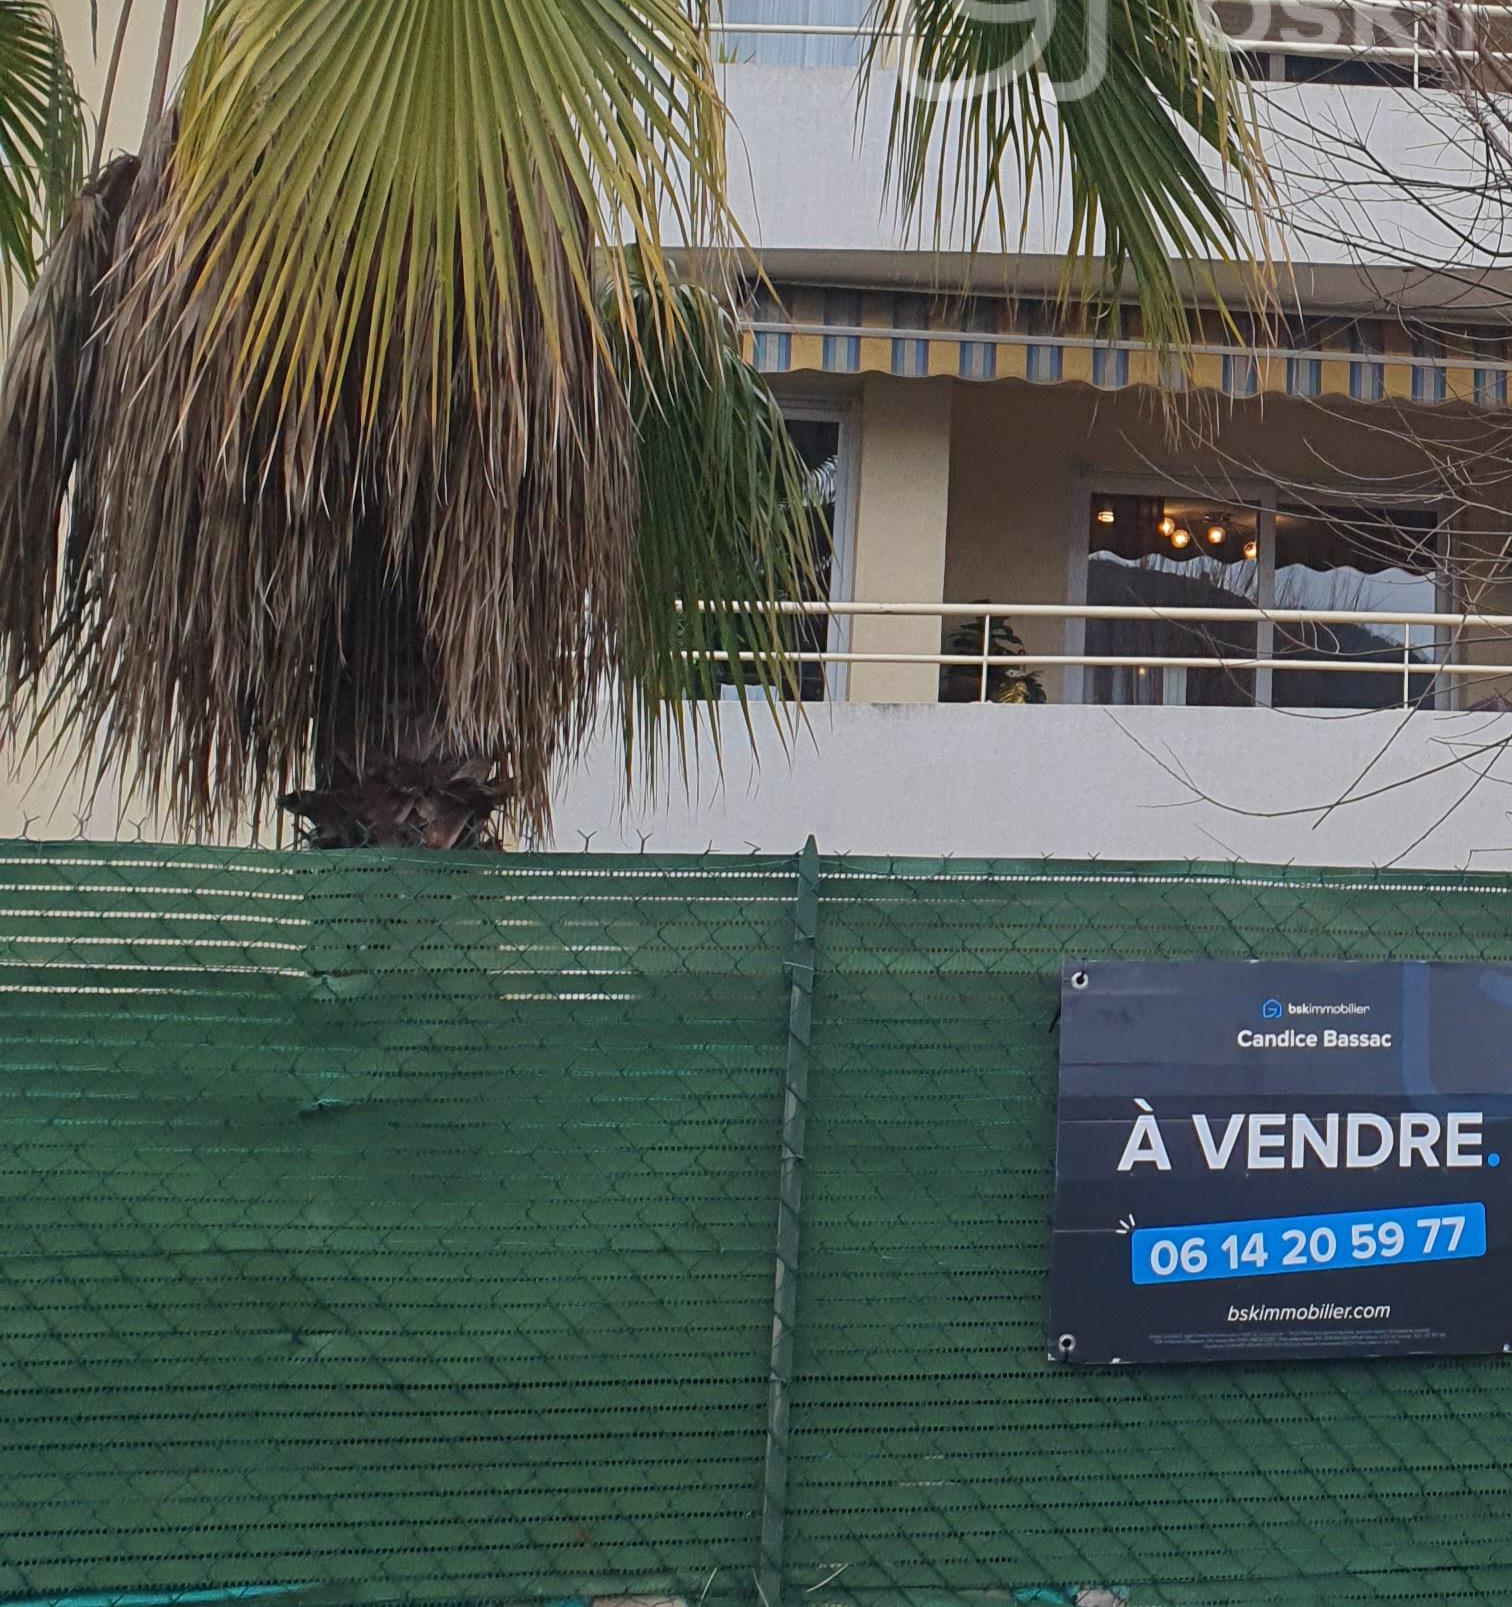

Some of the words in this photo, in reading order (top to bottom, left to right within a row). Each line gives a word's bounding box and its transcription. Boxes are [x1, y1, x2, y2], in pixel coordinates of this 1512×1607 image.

[1288, 1002, 1370, 1015] bskimmobilier
[1237, 1029, 1318, 1048] Candice
[1323, 1029, 1392, 1048] Bassac
[1117, 1098, 1172, 1172] À
[1150, 1238, 1208, 1276] 06
[1220, 1233, 1268, 1270] 14
[1281, 1228, 1337, 1266] 20
[1351, 1223, 1405, 1258] 59
[1416, 1216, 1466, 1253] 77
[1227, 1302, 1391, 1322] bskimmobilier.com
